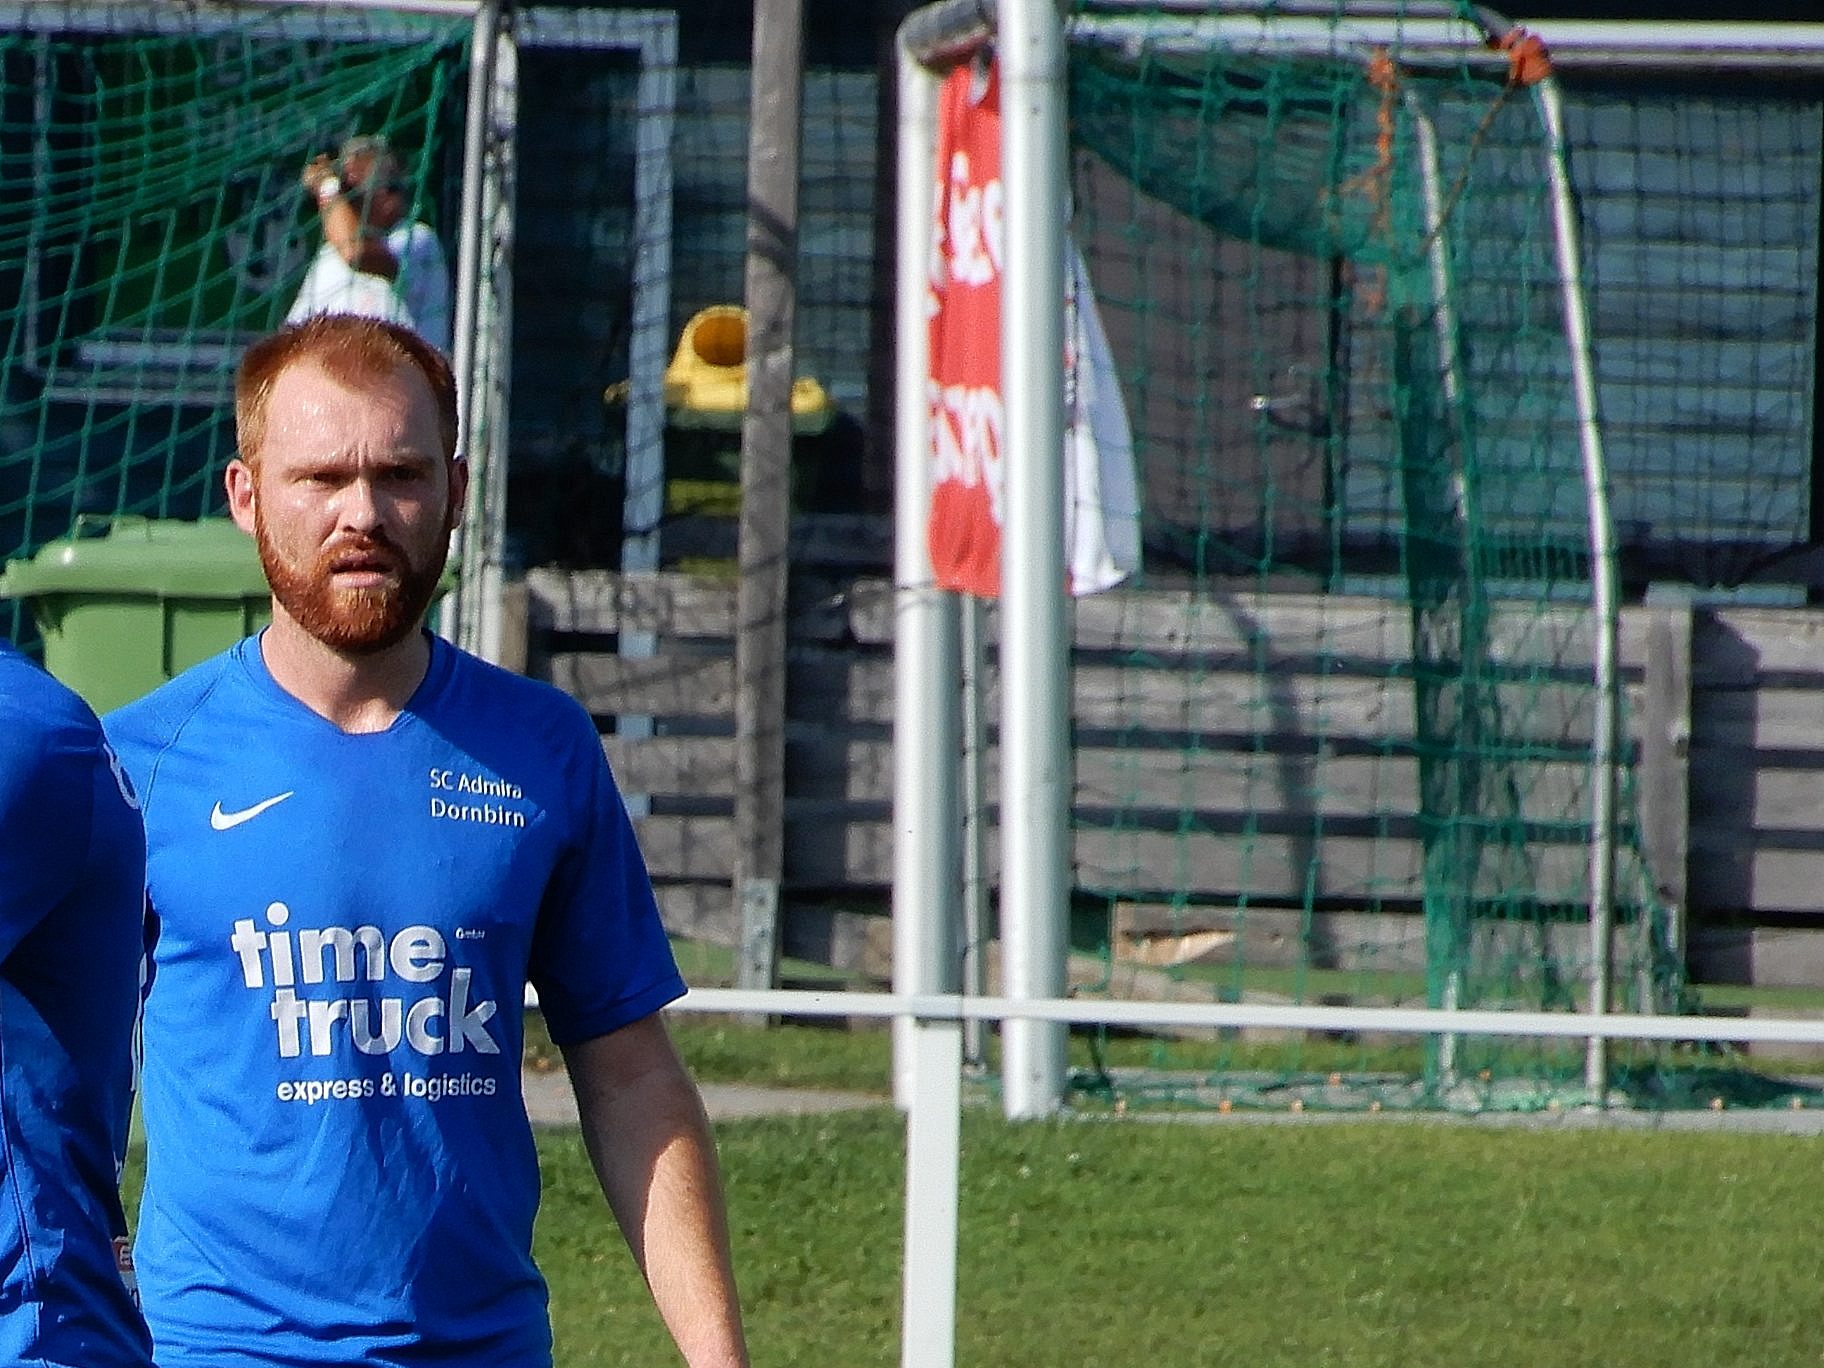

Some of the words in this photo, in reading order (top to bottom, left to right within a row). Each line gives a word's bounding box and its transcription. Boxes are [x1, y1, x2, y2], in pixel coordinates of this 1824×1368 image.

[430, 767, 454, 791] SC
[457, 773, 522, 799] Admira
[431, 797, 525, 828] Dornbirn
[231, 902, 446, 989] time
[271, 968, 501, 1058] truck
[277, 1078, 374, 1105] express
[380, 1071, 397, 1097] &
[403, 1071, 496, 1101] logistics
